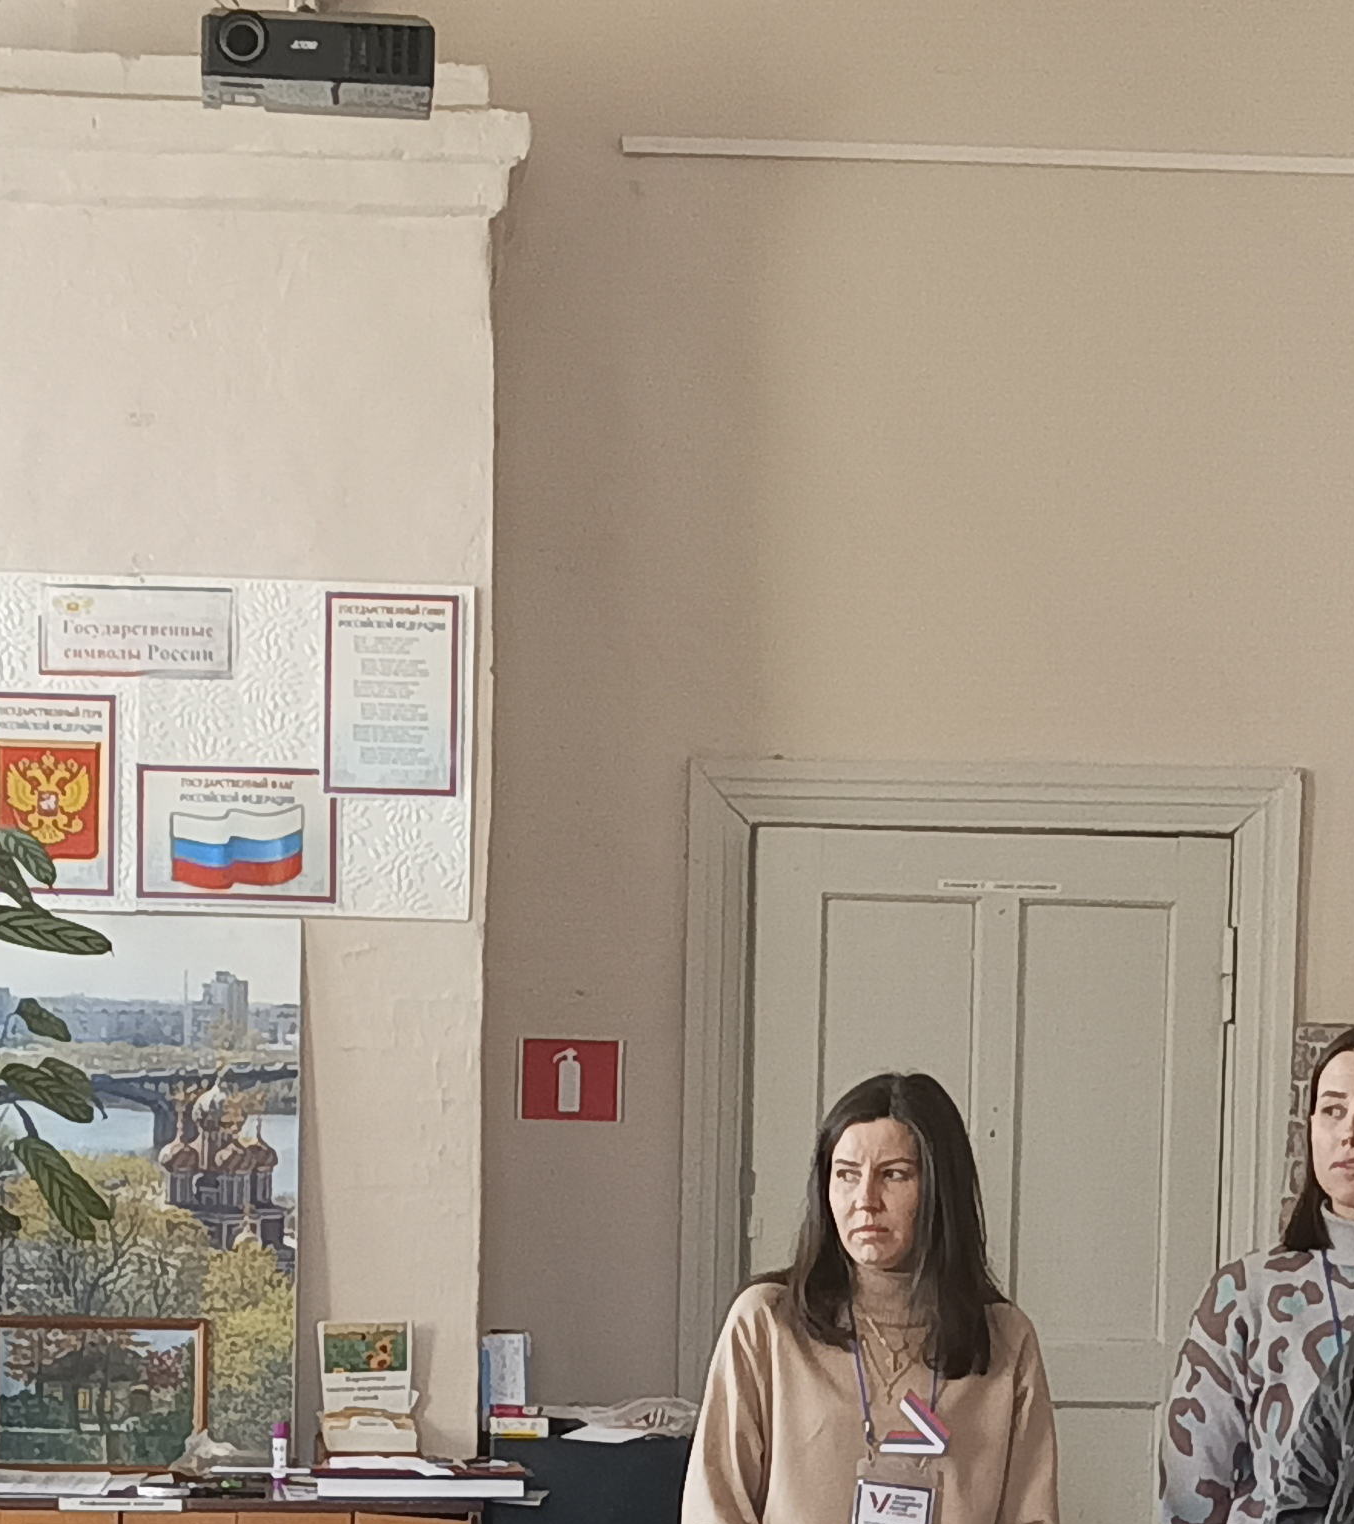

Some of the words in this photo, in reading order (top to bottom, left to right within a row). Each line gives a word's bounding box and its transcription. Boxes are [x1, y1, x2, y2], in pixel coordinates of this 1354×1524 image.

[63, 619, 214, 640] Государственные
[63, 647, 141, 661] символы
[147, 643, 214, 662] России
